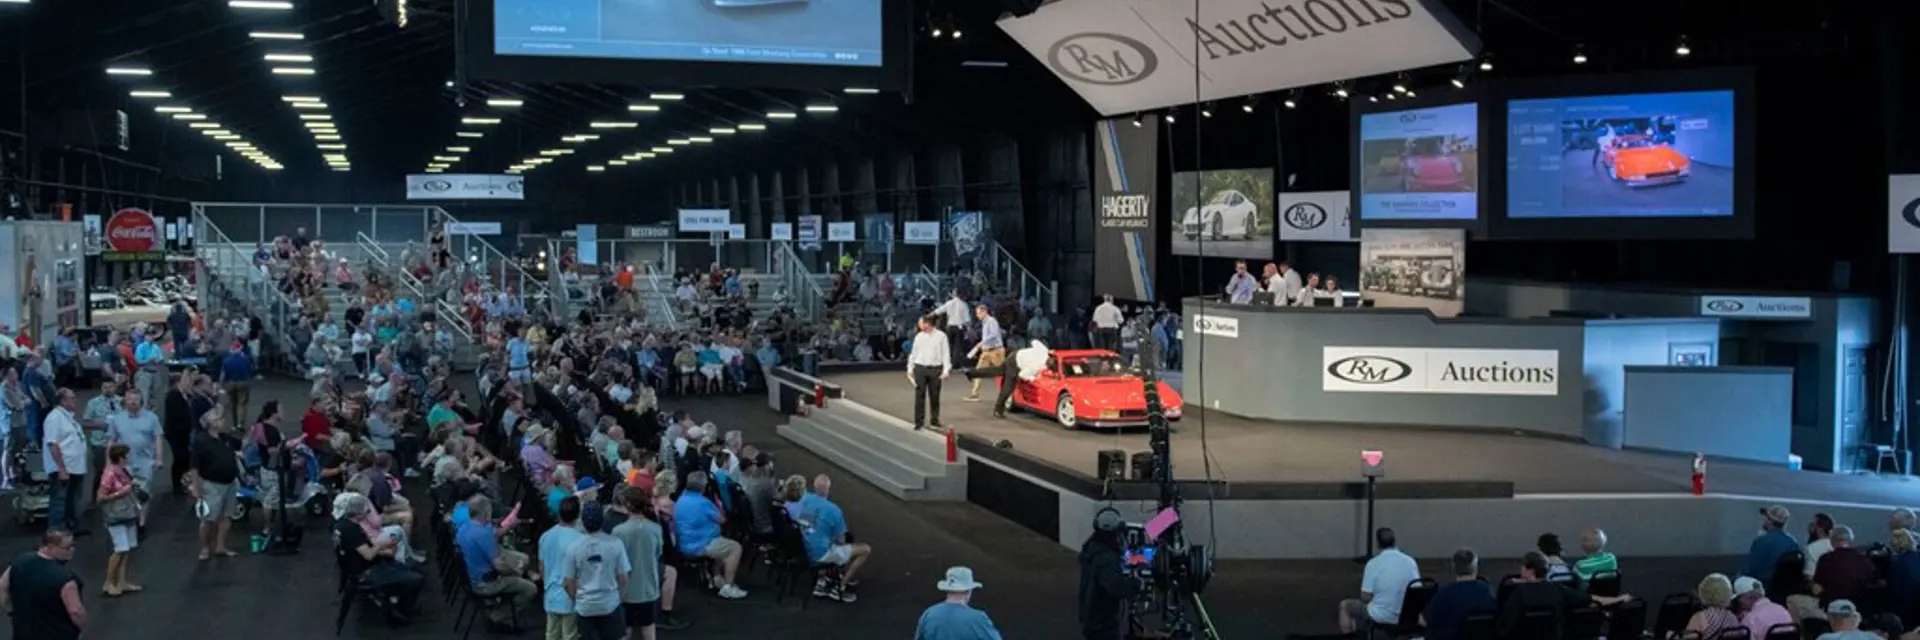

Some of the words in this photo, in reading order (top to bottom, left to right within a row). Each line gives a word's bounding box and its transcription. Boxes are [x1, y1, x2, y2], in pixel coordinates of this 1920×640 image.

[1063, 43, 1136, 81] RM
[1185, 0, 1413, 60] Auctions
[1101, 194, 1150, 217] HAGERTY
[631, 226, 669, 238] RESTROOM
[1757, 300, 1806, 313] Auctions
[1347, 359, 1390, 382] RM
[1440, 360, 1555, 384] Auctions
